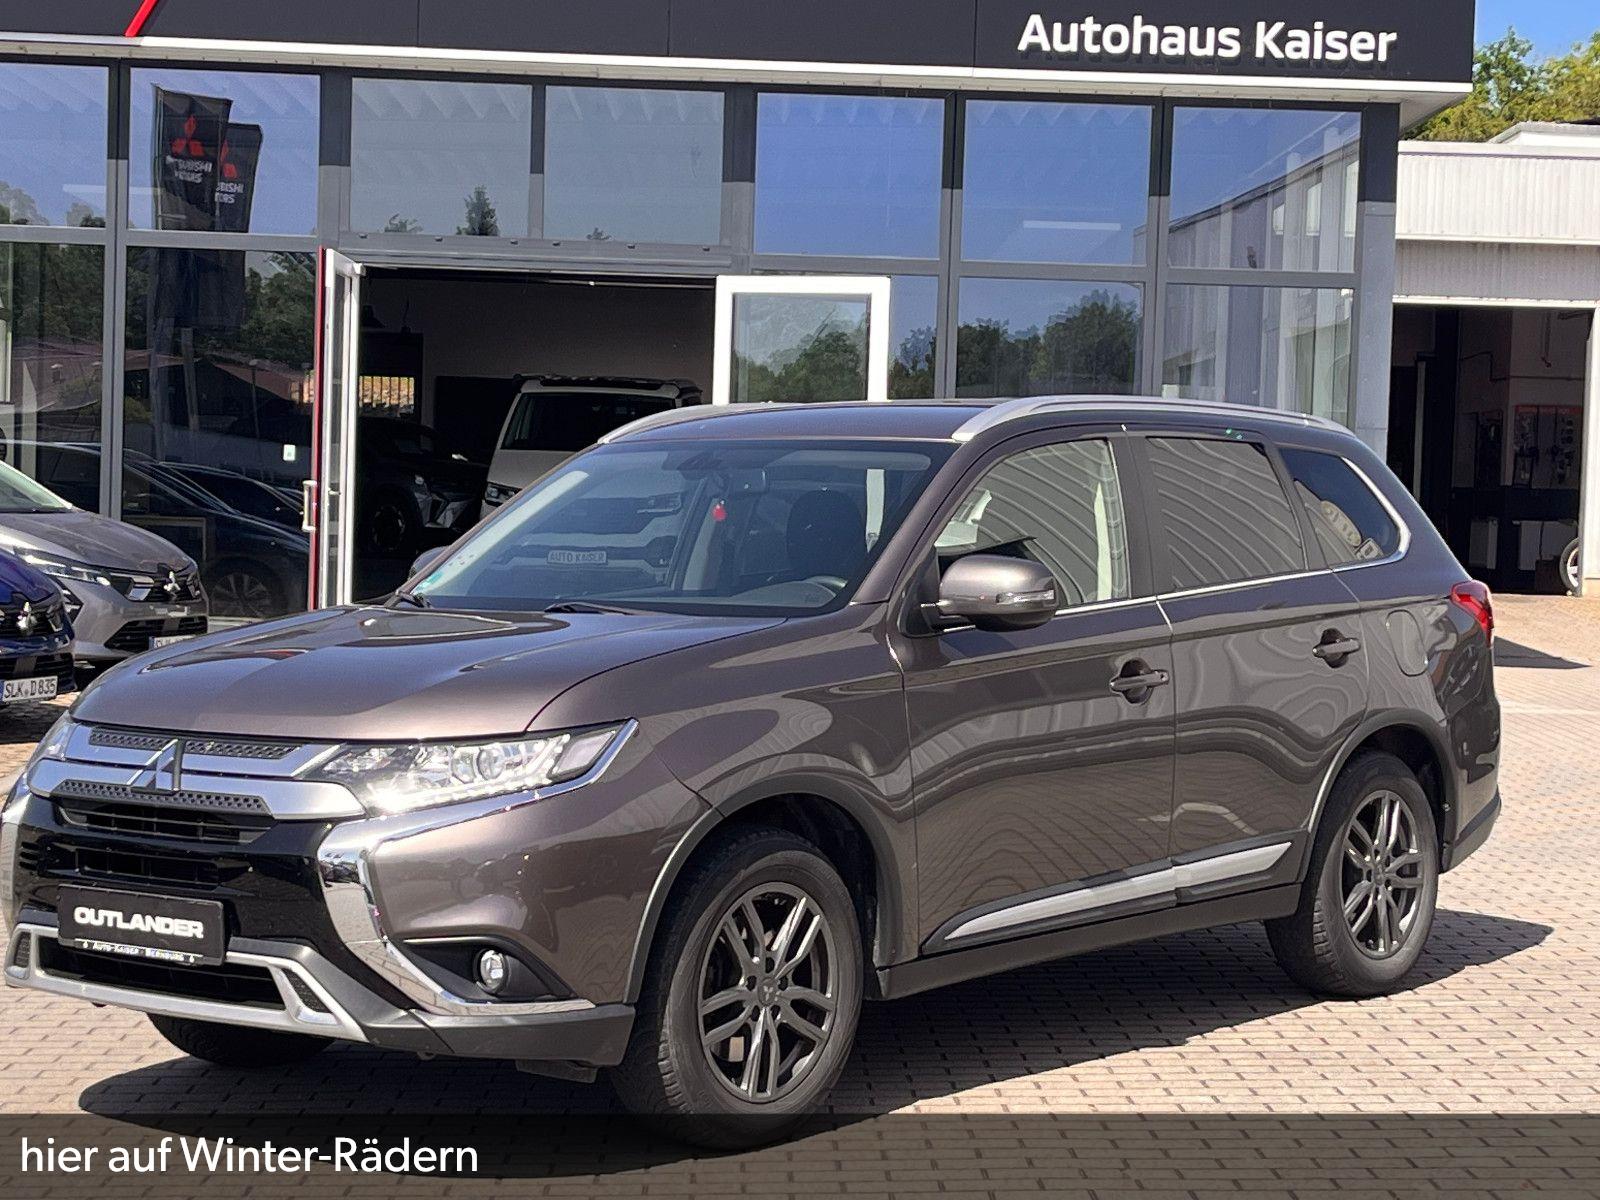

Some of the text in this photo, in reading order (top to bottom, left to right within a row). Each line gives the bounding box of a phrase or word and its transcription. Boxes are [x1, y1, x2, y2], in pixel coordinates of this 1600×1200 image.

[1017, 13, 1398, 62] Autohaus Kaiser
[550, 550, 573, 563] AUTO
[4, 681, 24, 699] SLK
[74, 906, 204, 939] OUTLANDER
